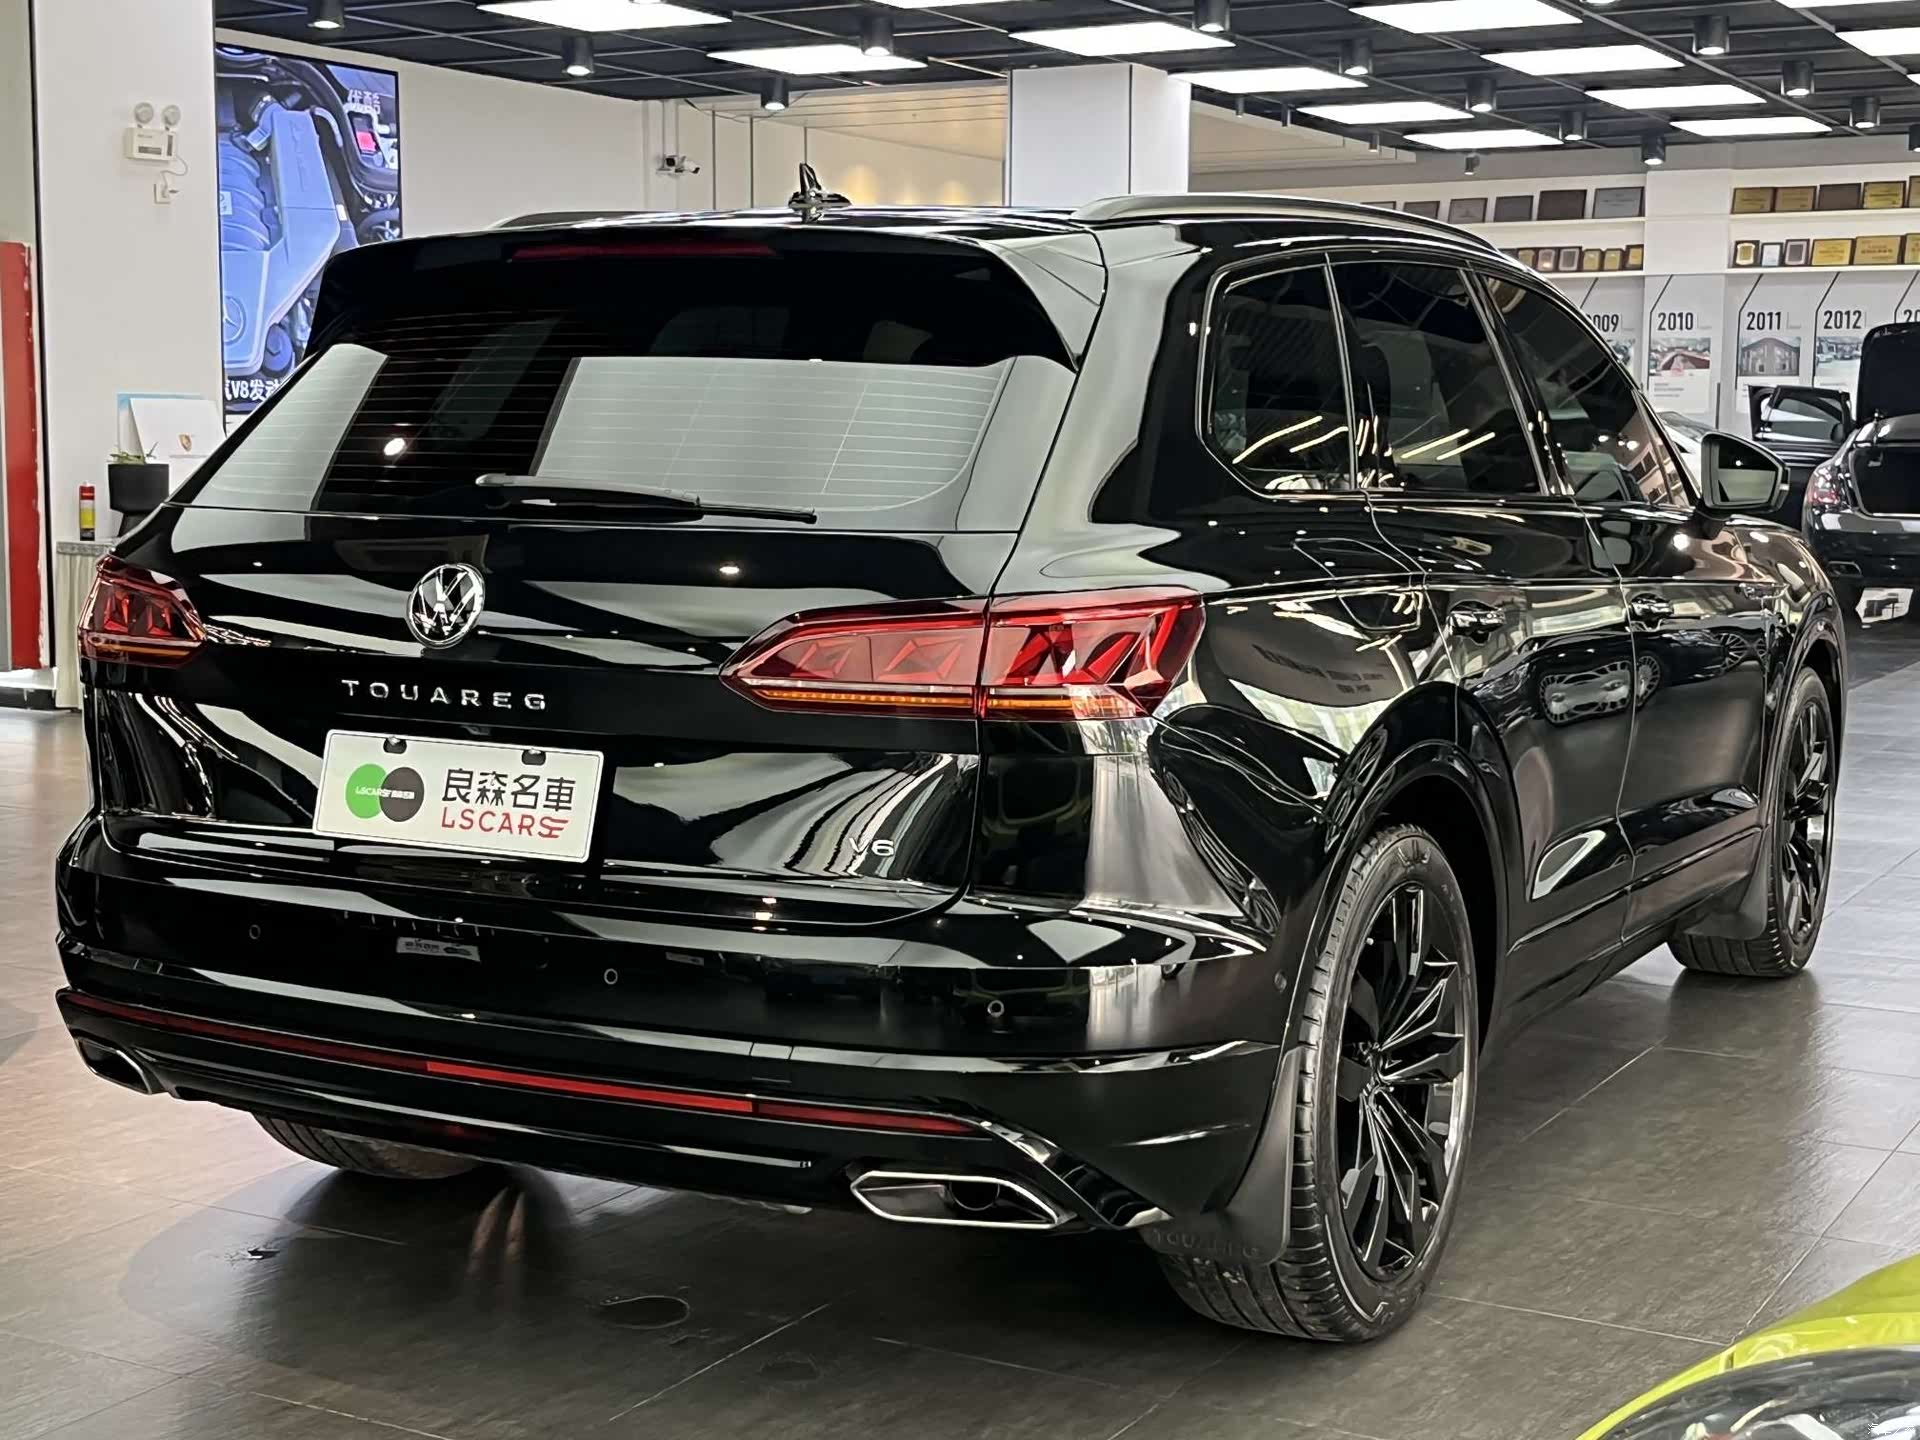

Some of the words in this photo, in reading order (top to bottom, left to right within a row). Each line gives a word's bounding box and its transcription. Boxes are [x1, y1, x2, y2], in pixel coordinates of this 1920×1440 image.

[1657, 312, 1694, 331] 2010
[1746, 311, 1782, 331] 2011
[1823, 310, 1862, 329] 2012
[341, 679, 546, 710] TOUAREG
[442, 768, 576, 811] 良森名車
[441, 807, 569, 838] LSCARS
[849, 839, 895, 857] V6
